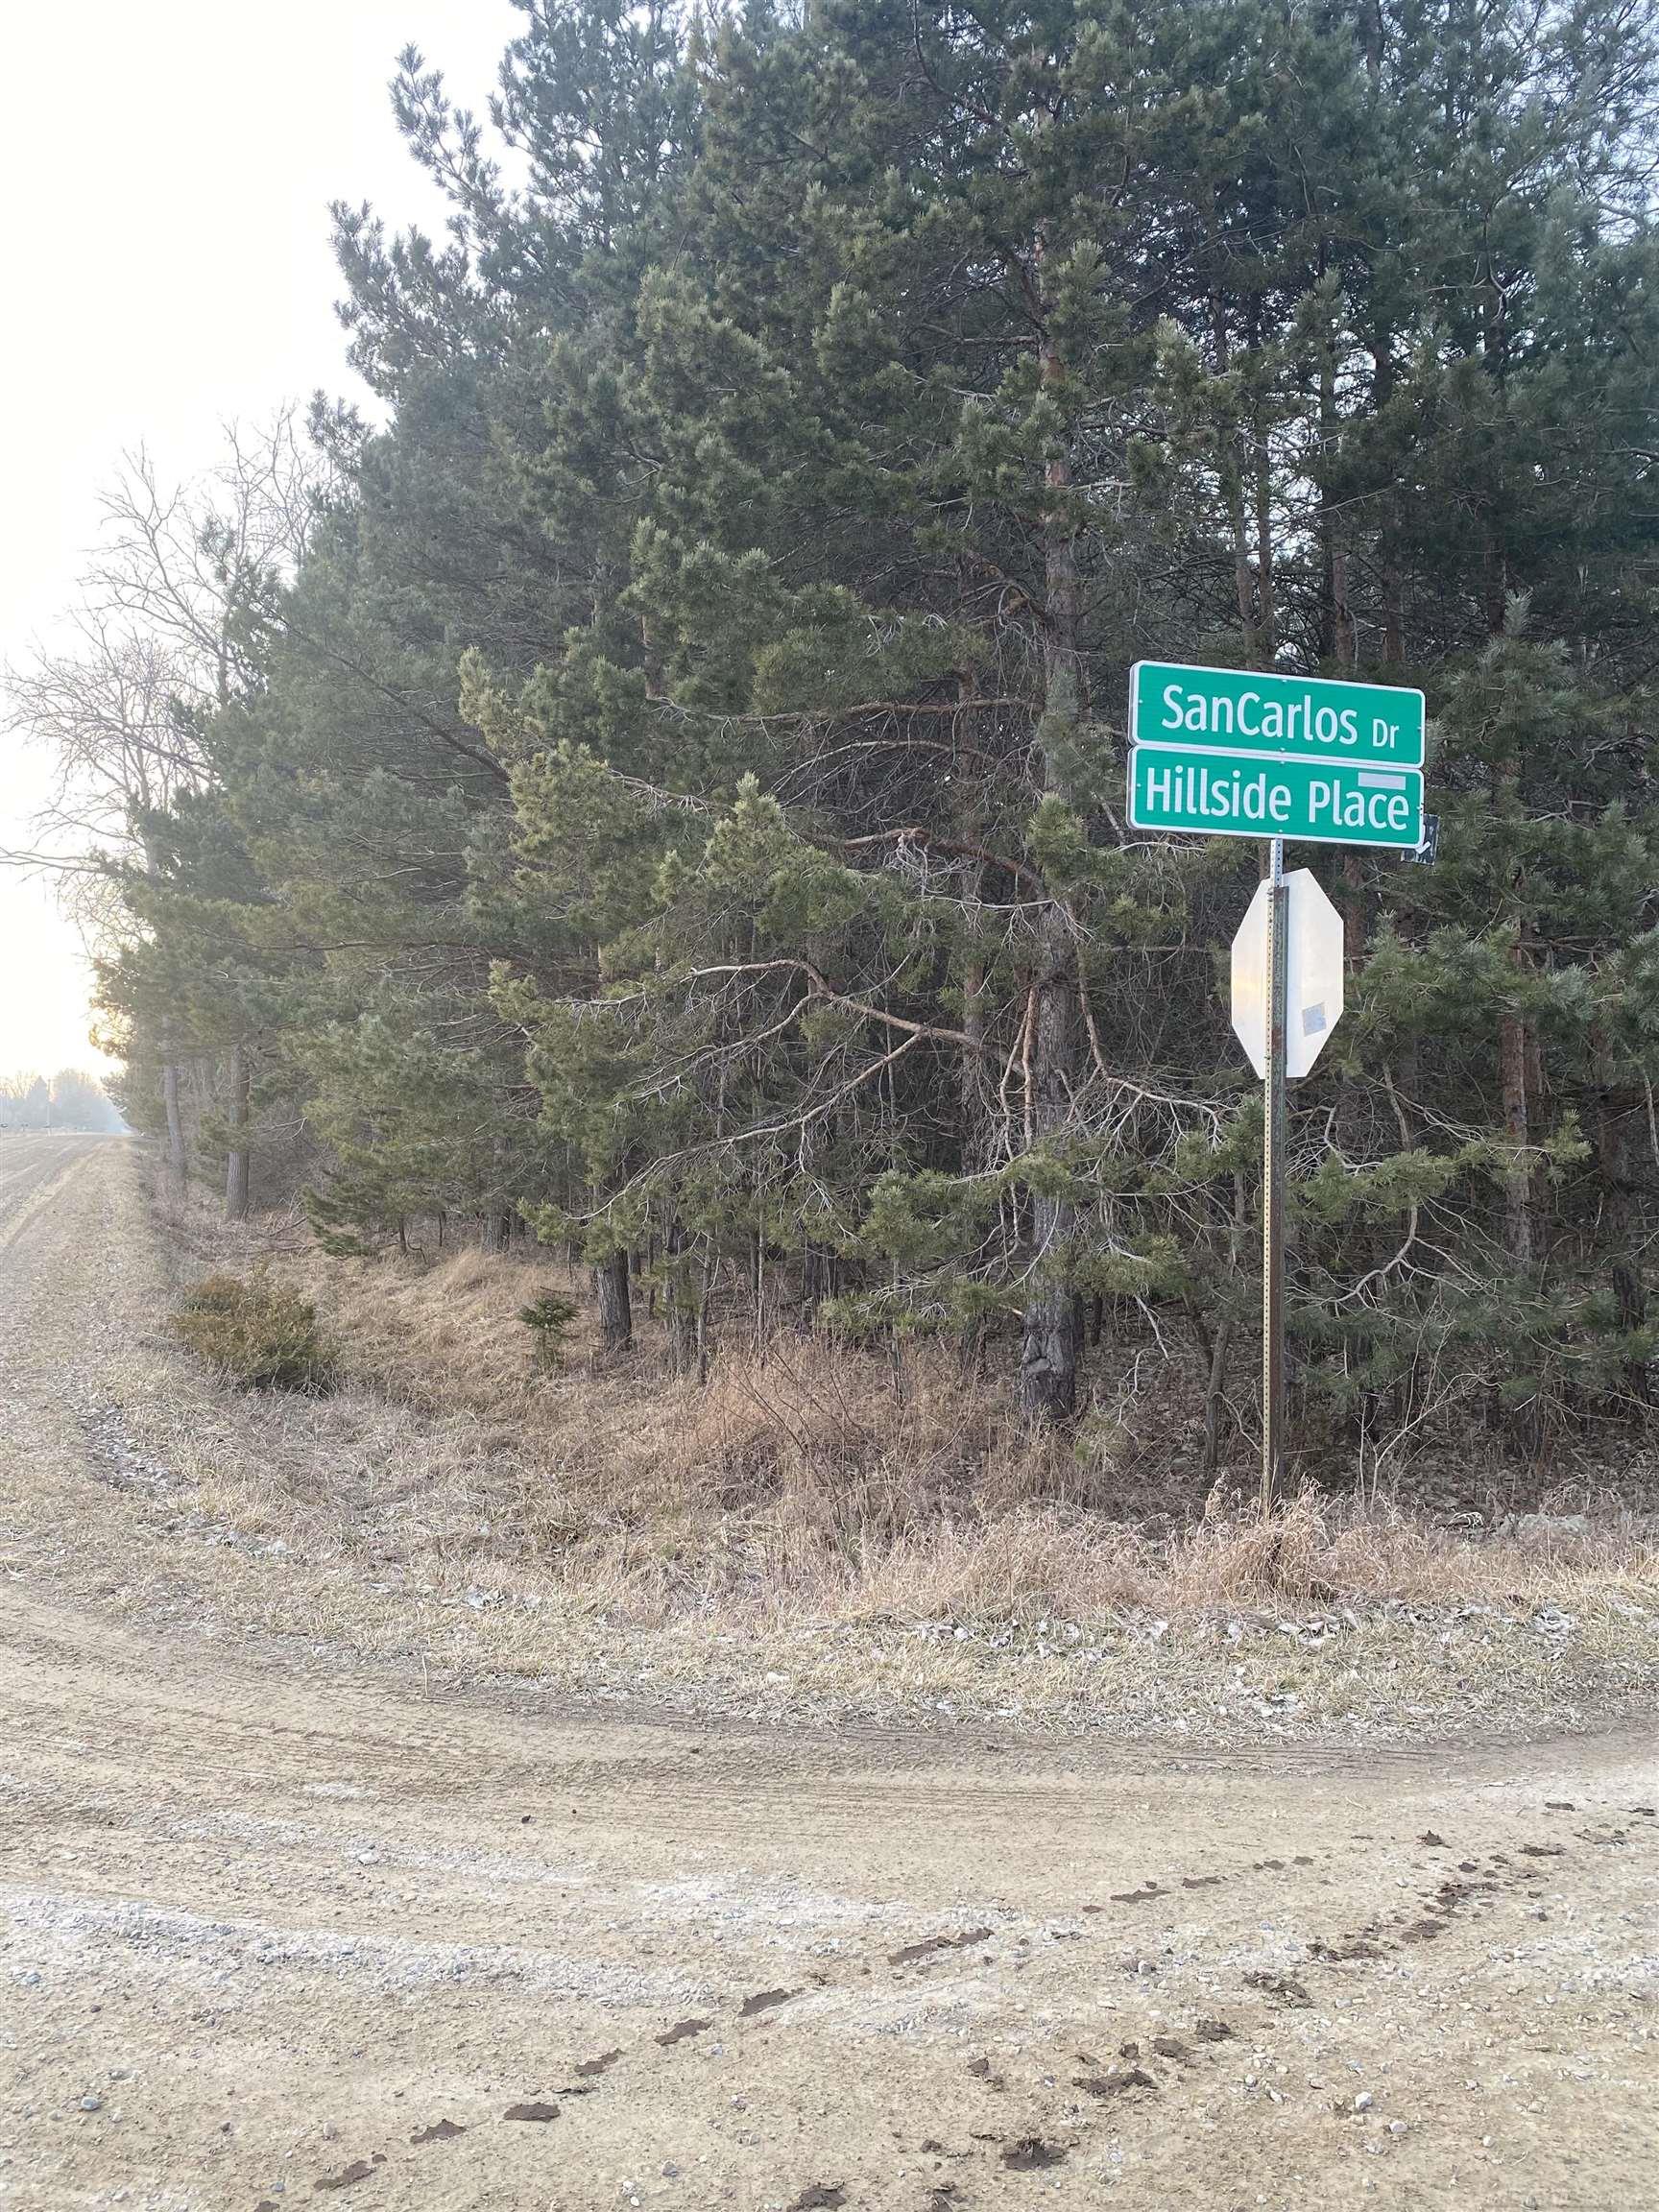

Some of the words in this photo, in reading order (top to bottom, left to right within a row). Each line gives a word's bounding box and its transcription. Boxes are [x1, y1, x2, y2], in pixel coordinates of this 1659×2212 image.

[1162, 685, 1358, 746] SanCarlos
[1372, 718, 1400, 749] Dr
[1146, 765, 1291, 822] Hillside
[1309, 780, 1409, 831] Place
